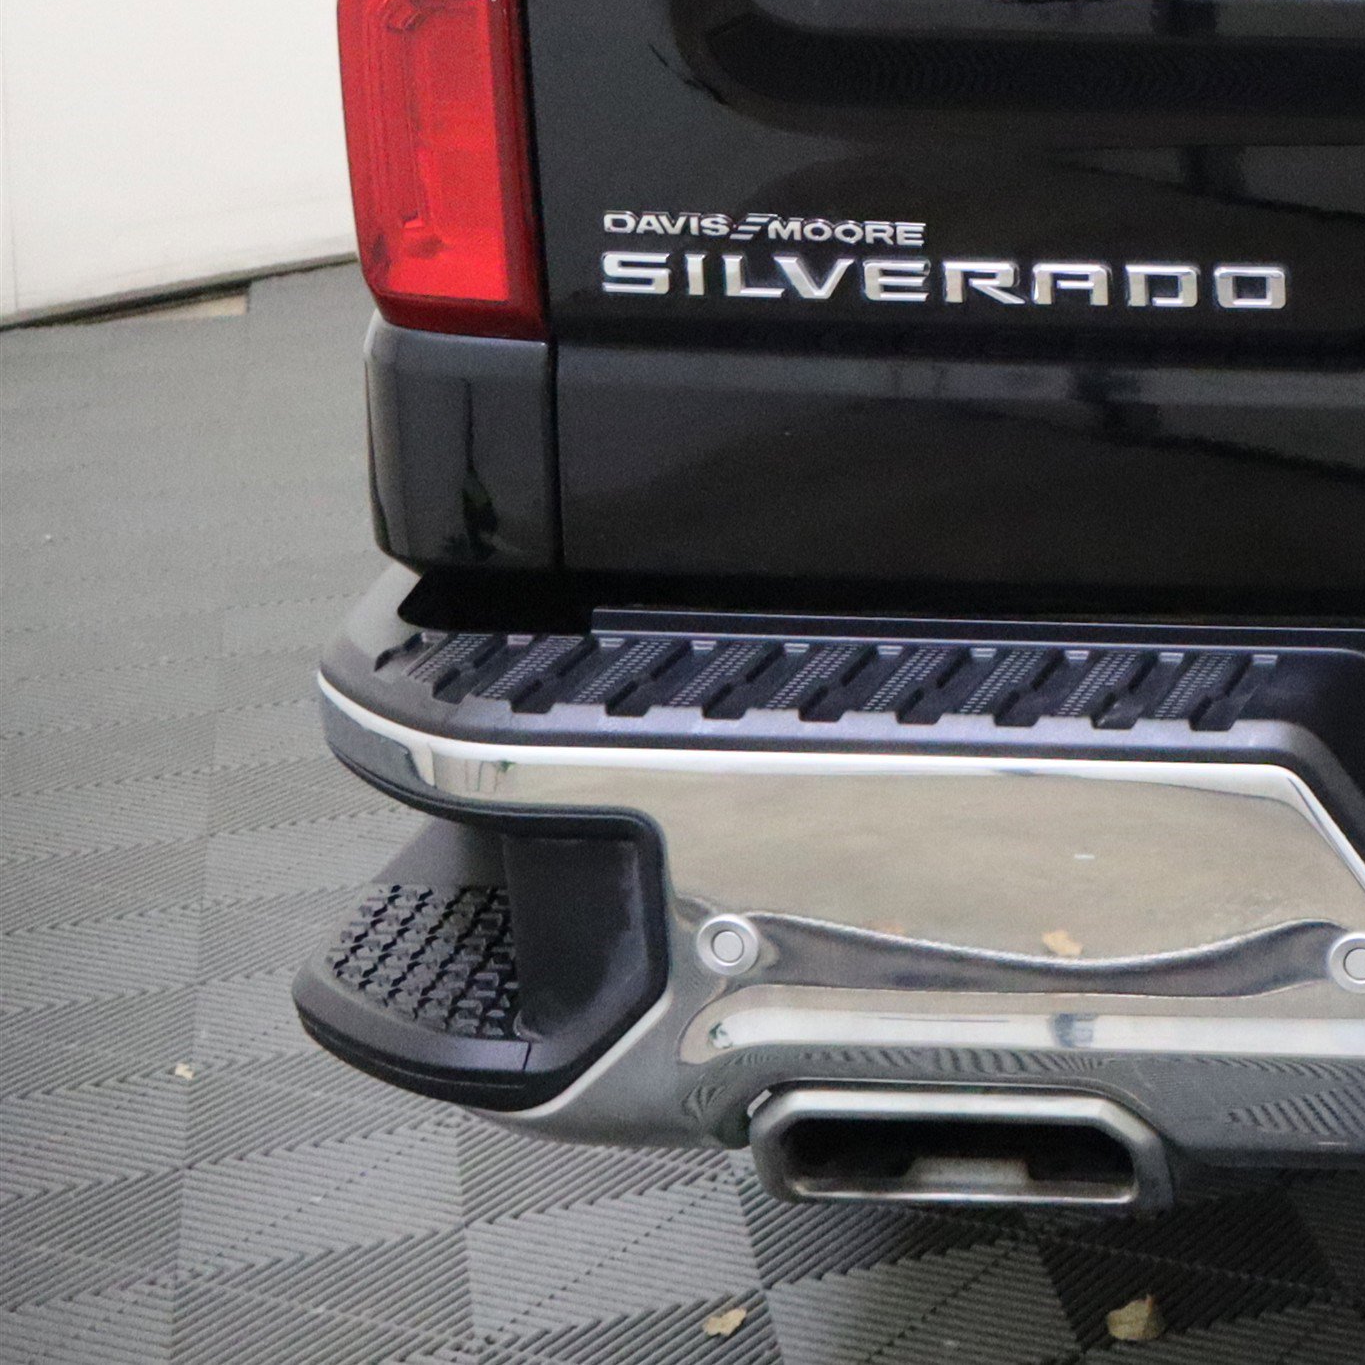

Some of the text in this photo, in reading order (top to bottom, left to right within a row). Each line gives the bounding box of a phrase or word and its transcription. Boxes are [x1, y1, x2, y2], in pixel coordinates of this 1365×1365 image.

[603, 211, 926, 246] DAVIS MOORE
[601, 251, 1288, 309] SILVERADO
